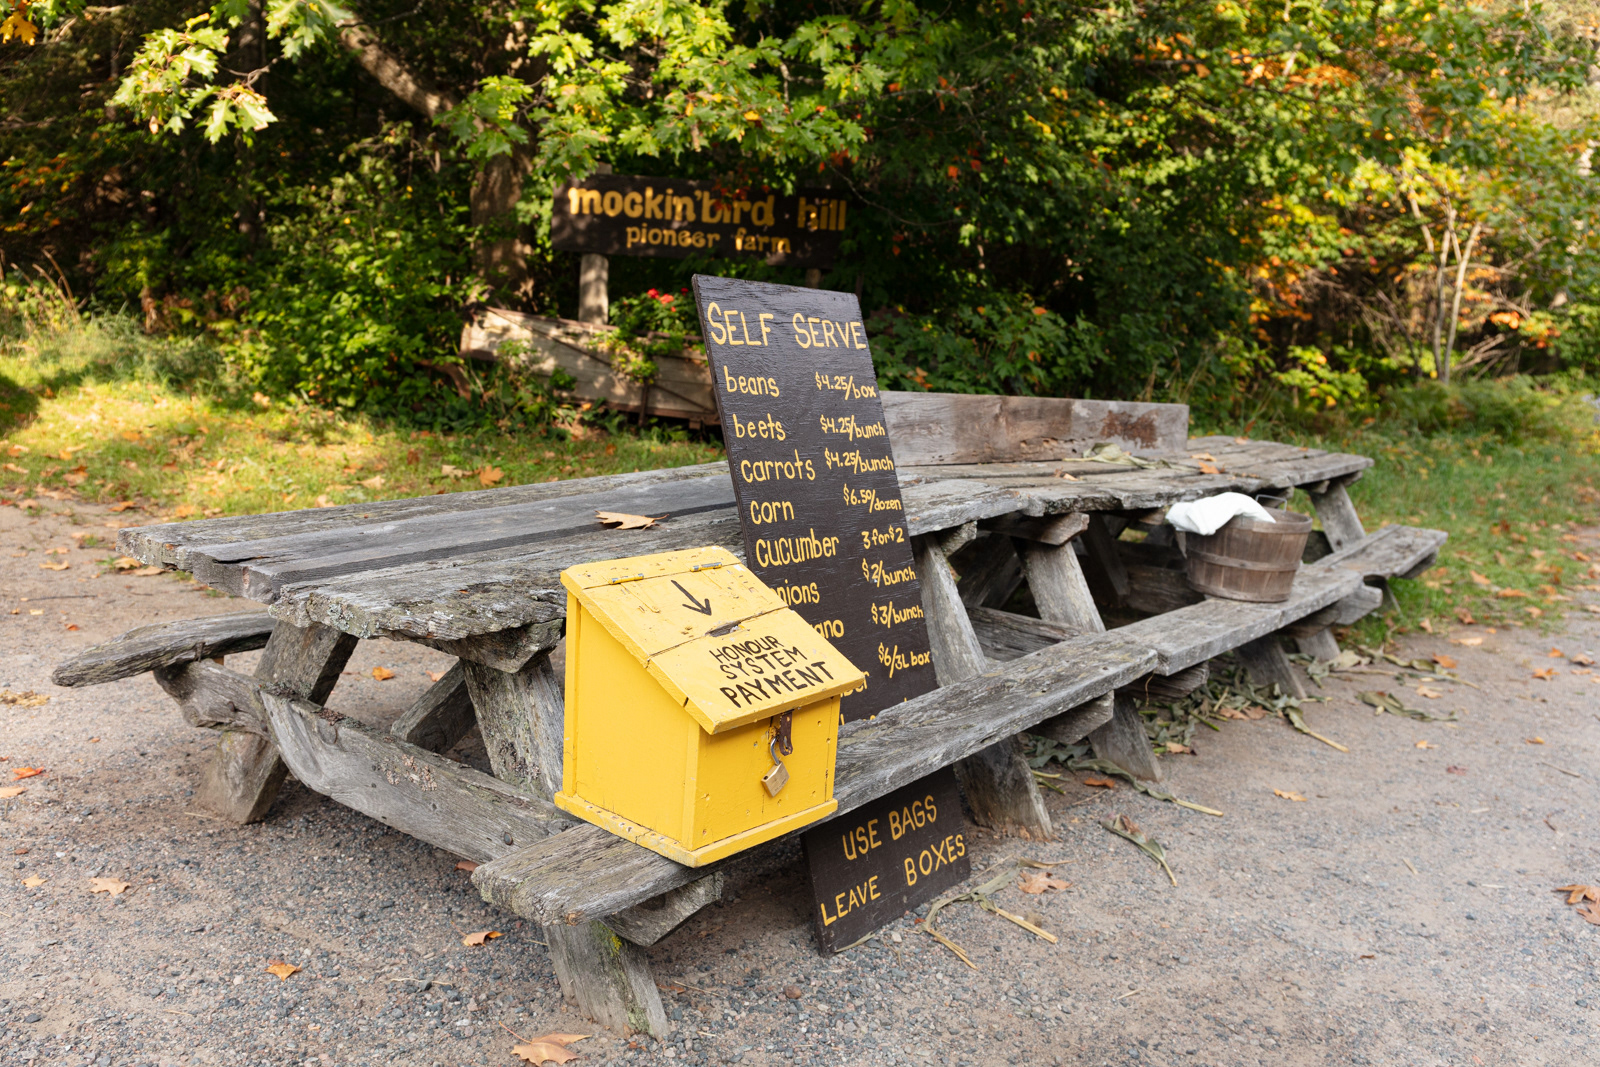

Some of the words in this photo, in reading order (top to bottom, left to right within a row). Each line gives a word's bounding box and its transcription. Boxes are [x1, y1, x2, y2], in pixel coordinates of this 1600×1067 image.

[797, 197, 847, 230] hill
[626, 223, 720, 248] pioneer
[735, 228, 791, 254] farm
[707, 302, 774, 346] SELF
[792, 312, 867, 350] SERVE
[723, 365, 780, 398] beans
[815, 371, 877, 400] $4.25/box
[732, 413, 786, 441] beets
[819, 414, 886, 441] $4.25/bunch
[740, 449, 816, 483] carrots
[824, 447, 894, 474] $4.25/bunch
[750, 500, 795, 525] corn
[843, 483, 902, 514] $6.50/dozen
[755, 528, 840, 568] cucumber
[770, 579, 820, 606] nions
[861, 558, 916, 587] $2/bunch
[871, 601, 924, 628] $3/bunch
[709, 635, 784, 663] HONOUR
[720, 646, 808, 680] SYSTEM
[910, 651, 930, 667] box
[719, 661, 834, 708] PAYMENT
[842, 819, 882, 860] USE
[889, 795, 937, 840] BAGS
[820, 875, 881, 926] LEAVE
[904, 834, 965, 886] BOXES
